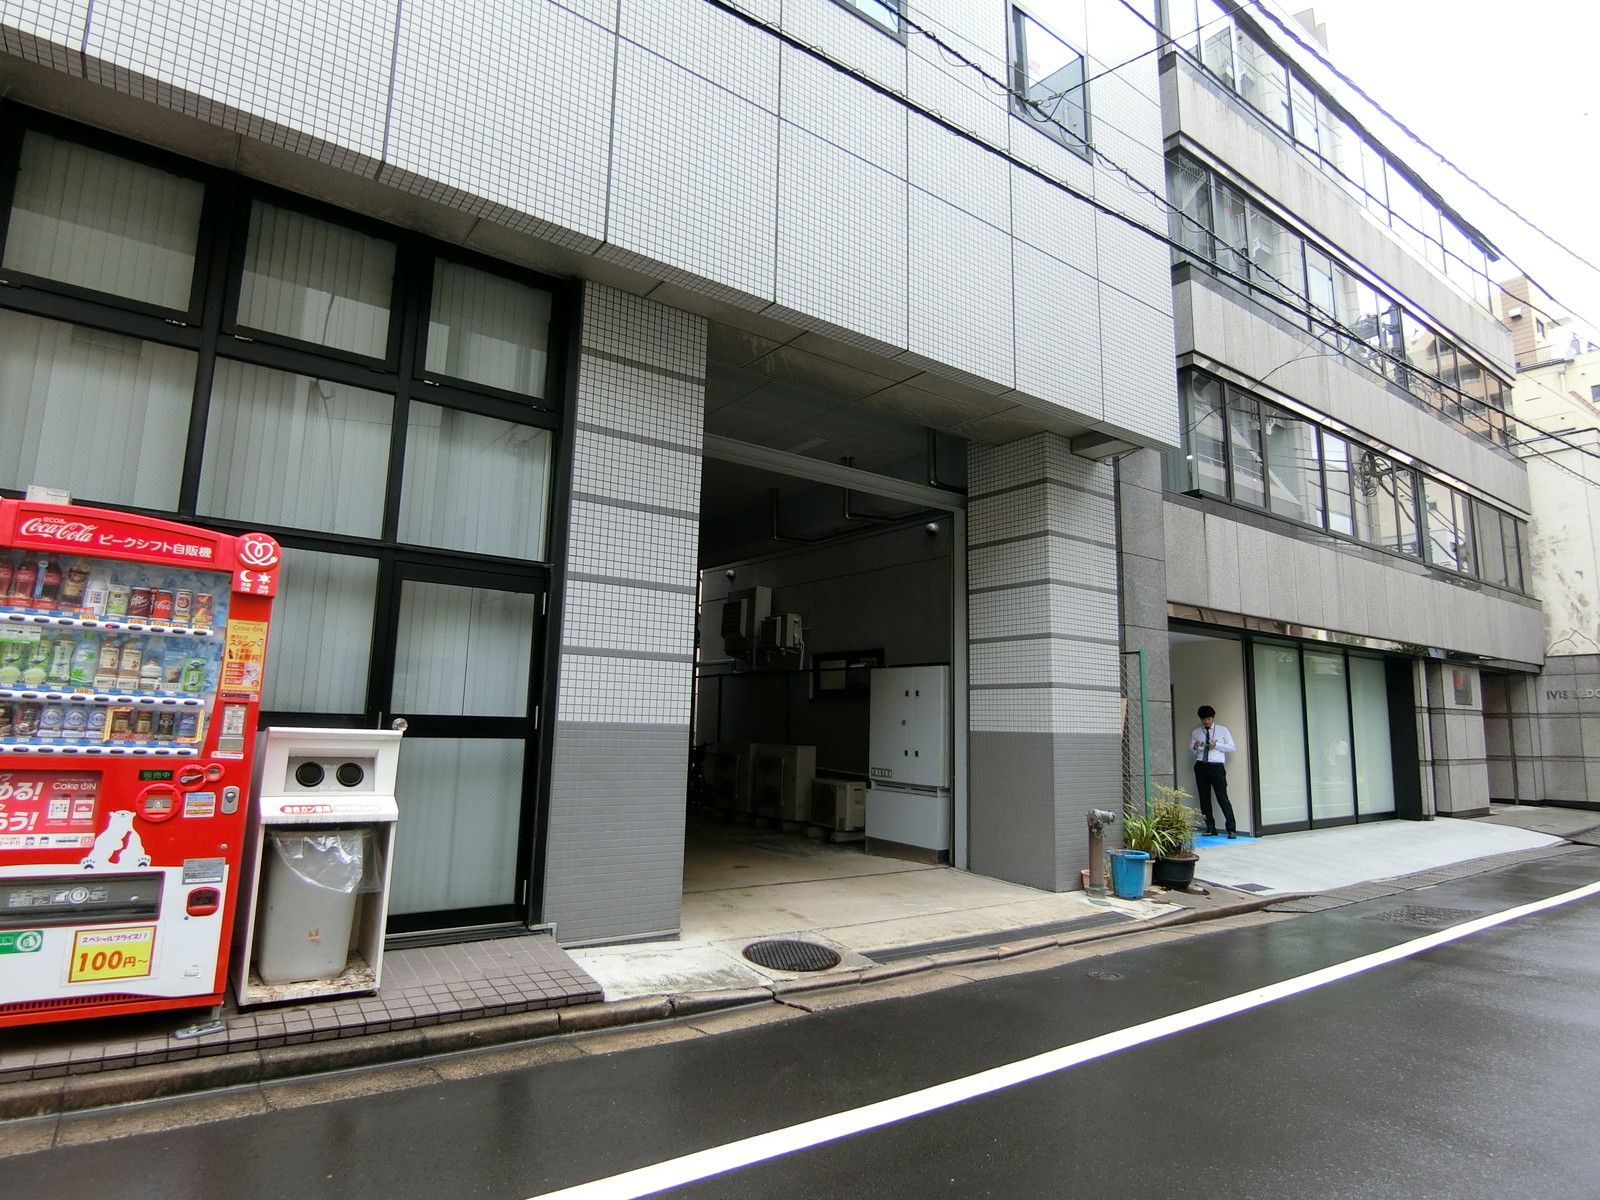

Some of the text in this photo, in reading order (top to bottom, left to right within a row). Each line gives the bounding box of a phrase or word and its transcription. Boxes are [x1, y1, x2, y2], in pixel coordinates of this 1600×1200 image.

[21, 517, 99, 543] Coca-Cola
[99, 533, 213, 559] ピークシフト自販機
[53, 782, 96, 790] Coke ON
